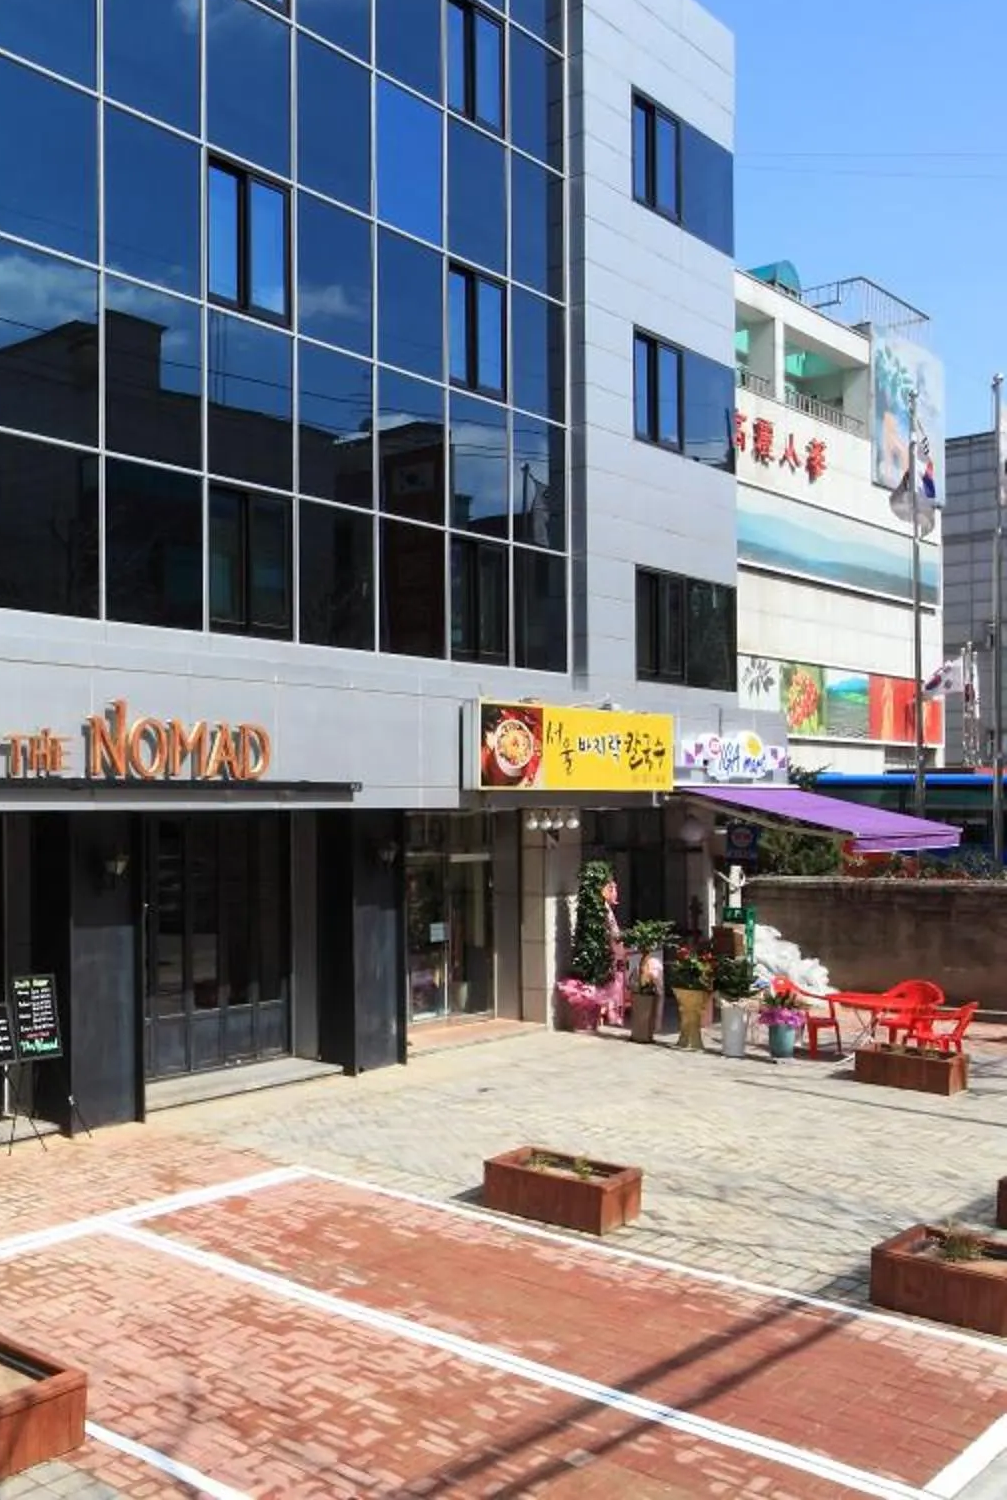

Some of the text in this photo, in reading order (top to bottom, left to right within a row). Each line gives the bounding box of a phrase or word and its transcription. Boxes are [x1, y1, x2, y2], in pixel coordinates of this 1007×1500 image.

[84, 697, 272, 781] NOMAD
[546, 720, 666, 775] 서울 바지락 칼국수
